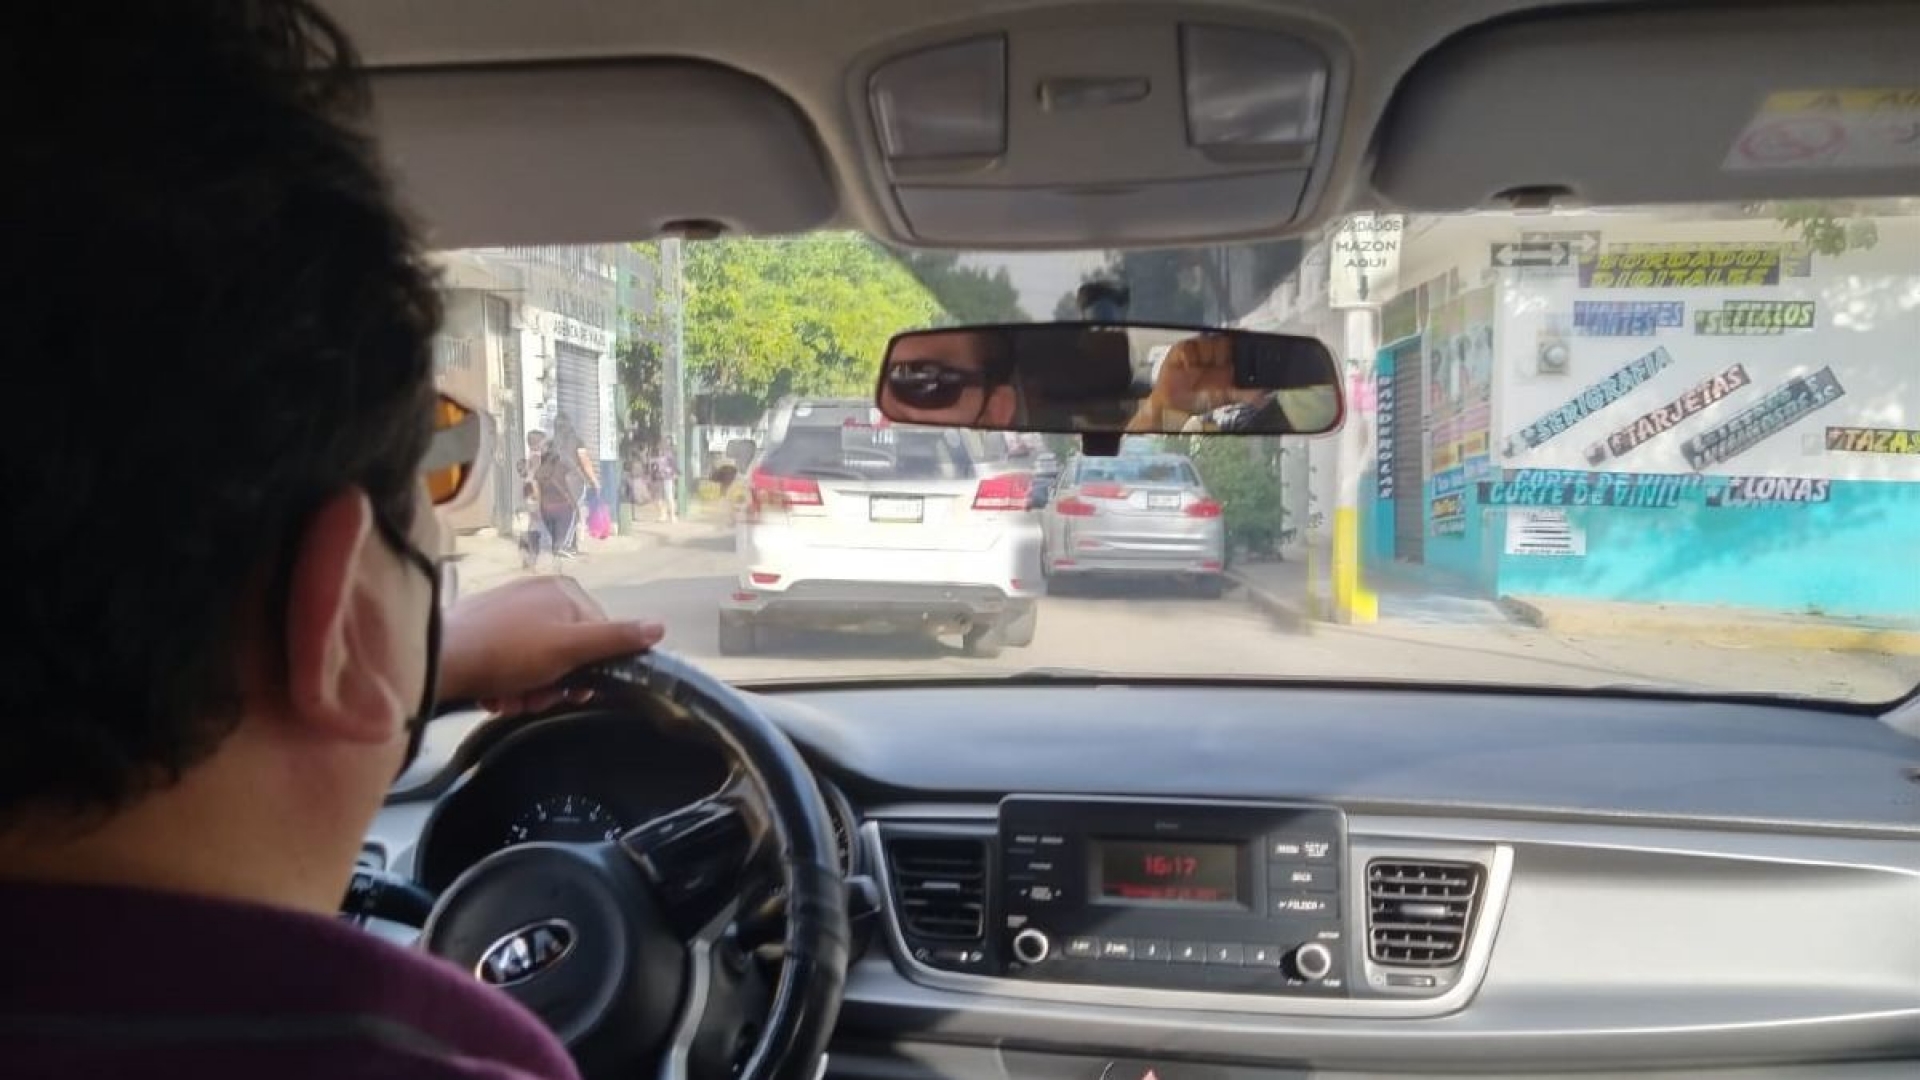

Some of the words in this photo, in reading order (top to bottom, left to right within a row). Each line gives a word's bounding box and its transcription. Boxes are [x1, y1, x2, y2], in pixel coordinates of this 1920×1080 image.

[1336, 241, 1396, 253] MAZON
[1343, 258, 1387, 268] AQUI
[1534, 348, 1670, 441] SERIGRAFIA
[1627, 366, 1744, 445] TARJETAS
[1741, 477, 1830, 502] LONAS
